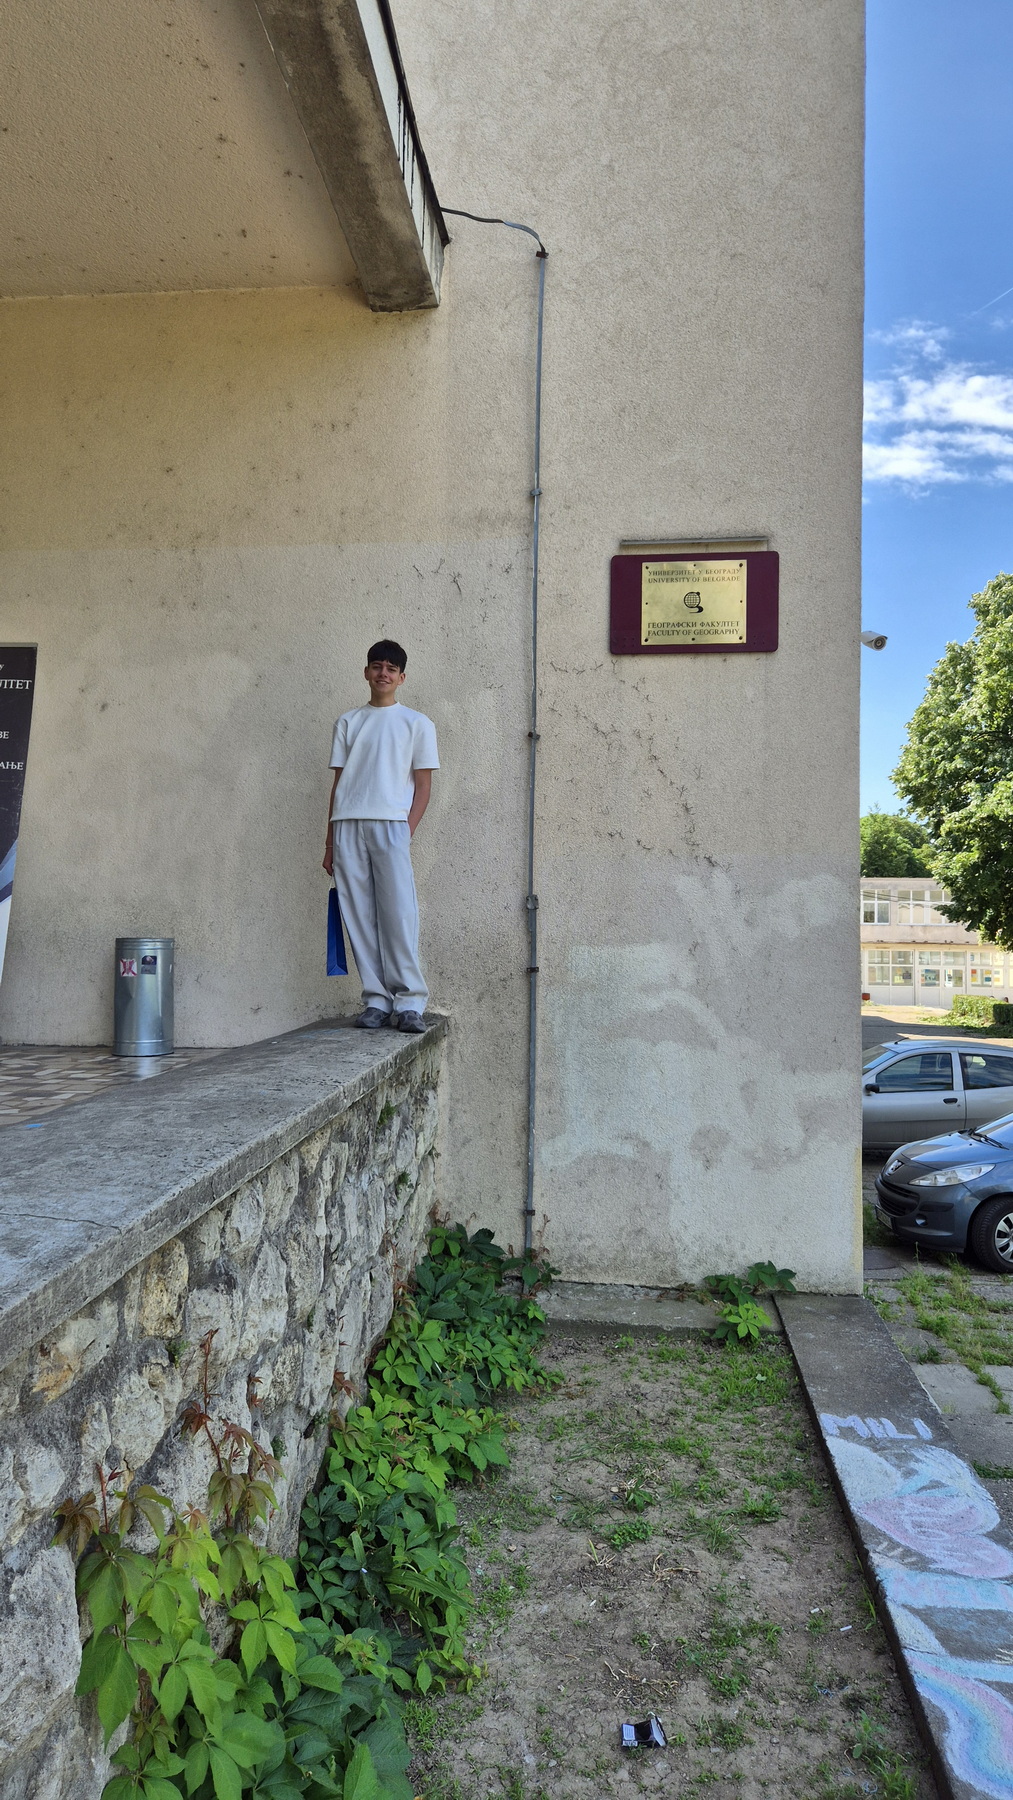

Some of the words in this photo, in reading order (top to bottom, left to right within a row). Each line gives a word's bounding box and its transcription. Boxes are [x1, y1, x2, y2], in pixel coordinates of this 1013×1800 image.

[648, 629, 681, 637] FACULTY
[693, 628, 740, 636] GEOGRAPHY
[820, 1413, 933, 1440] MILI
